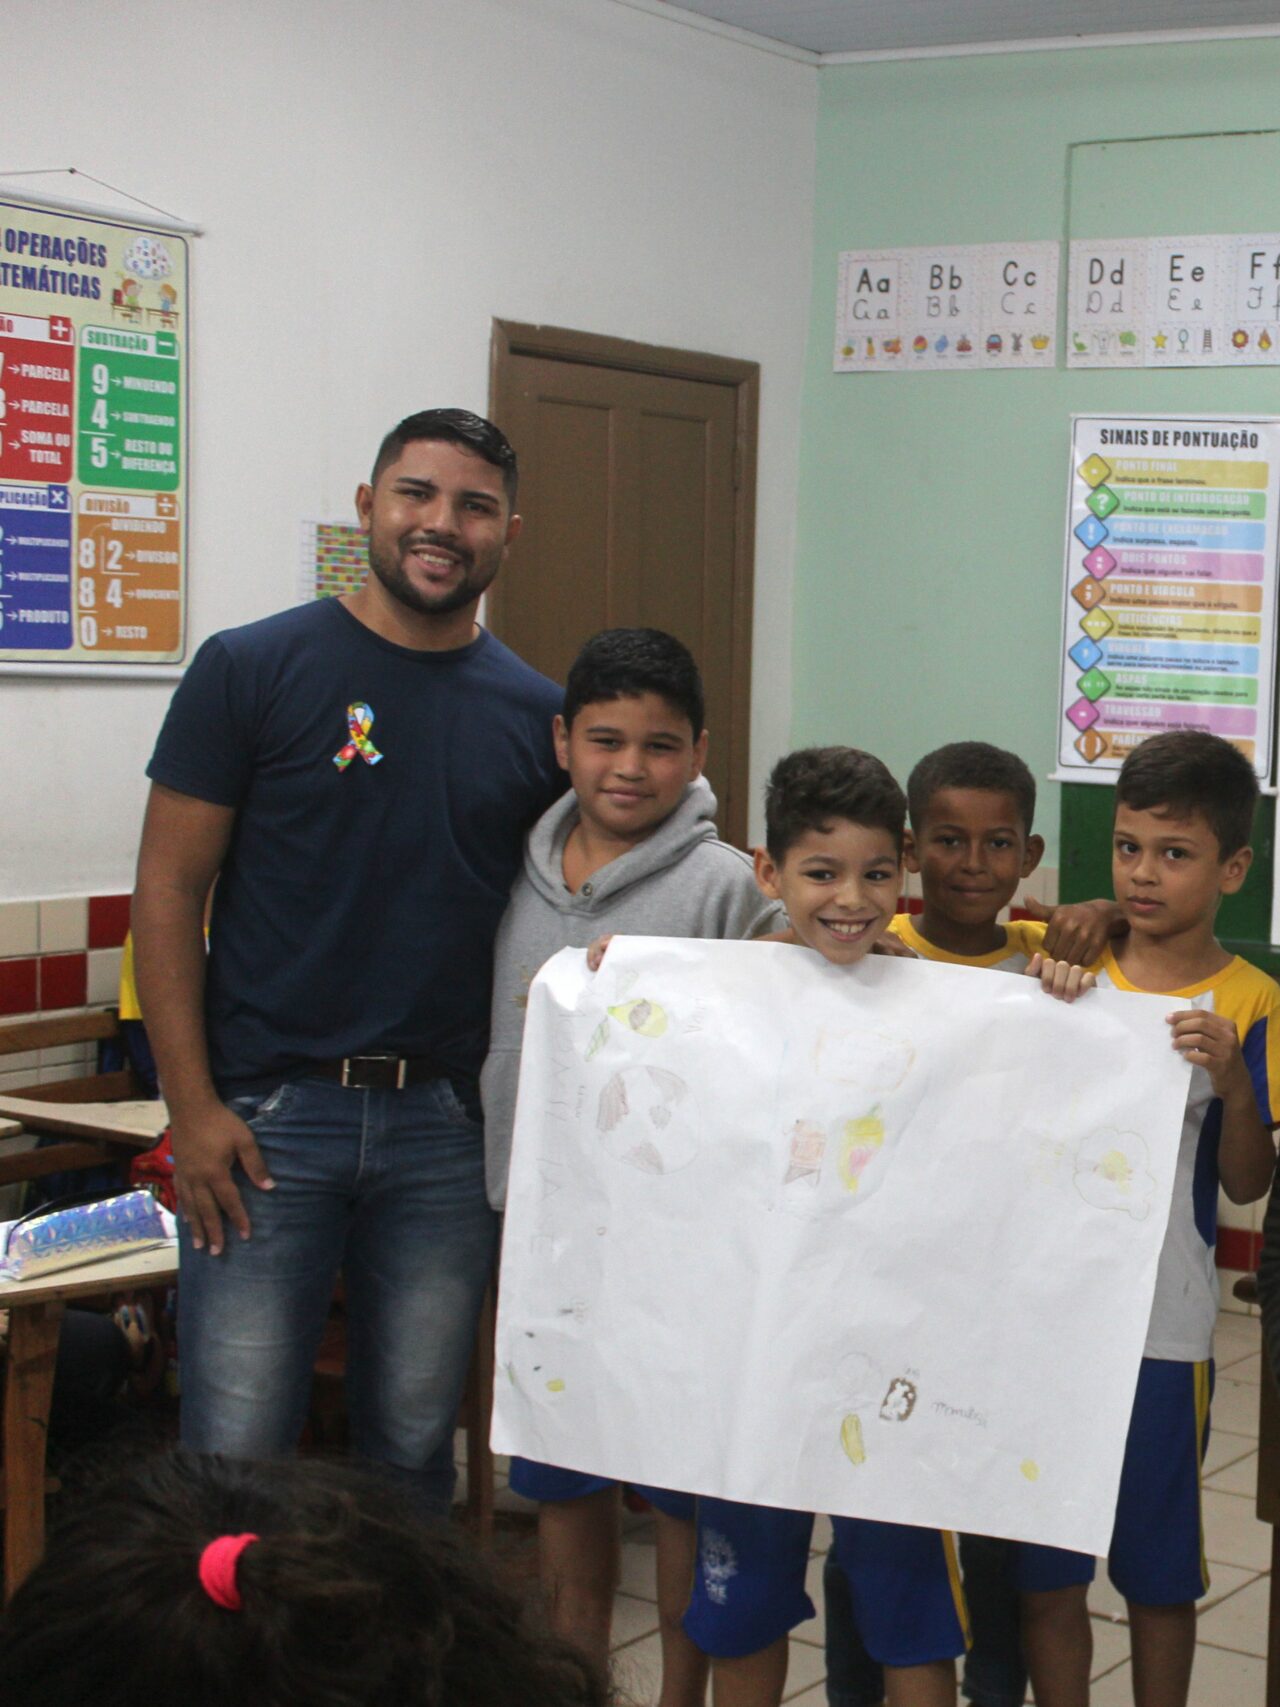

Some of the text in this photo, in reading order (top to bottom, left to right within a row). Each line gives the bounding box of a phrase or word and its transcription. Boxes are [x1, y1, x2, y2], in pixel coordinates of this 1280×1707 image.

[5, 228, 107, 268] OPERAÇÕES
[0, 262, 102, 300] TEMÁTICAS
[856, 261, 1037, 294] Aa Bb Cc
[1089, 258, 1126, 284] Dd
[1169, 255, 1205, 282] Ee
[21, 364, 71, 383] PARCELA
[92, 363, 109, 395] 9
[21, 399, 70, 418] PARCELA
[91, 399, 108, 430] 4
[21, 429, 54, 446] SOMA
[54, 432, 71, 448] OU
[91, 436, 108, 468] 5
[1100, 429, 1259, 451] SINAIS DE PONTUAÇÃO
[29, 448, 62, 465] TOTAL
[79, 538, 96, 569] 8
[106, 540, 123, 570] 2
[79, 577, 95, 608] 8
[106, 578, 123, 609] 4
[19, 609, 69, 624] PRODUTO
[80, 616, 98, 647] 0
